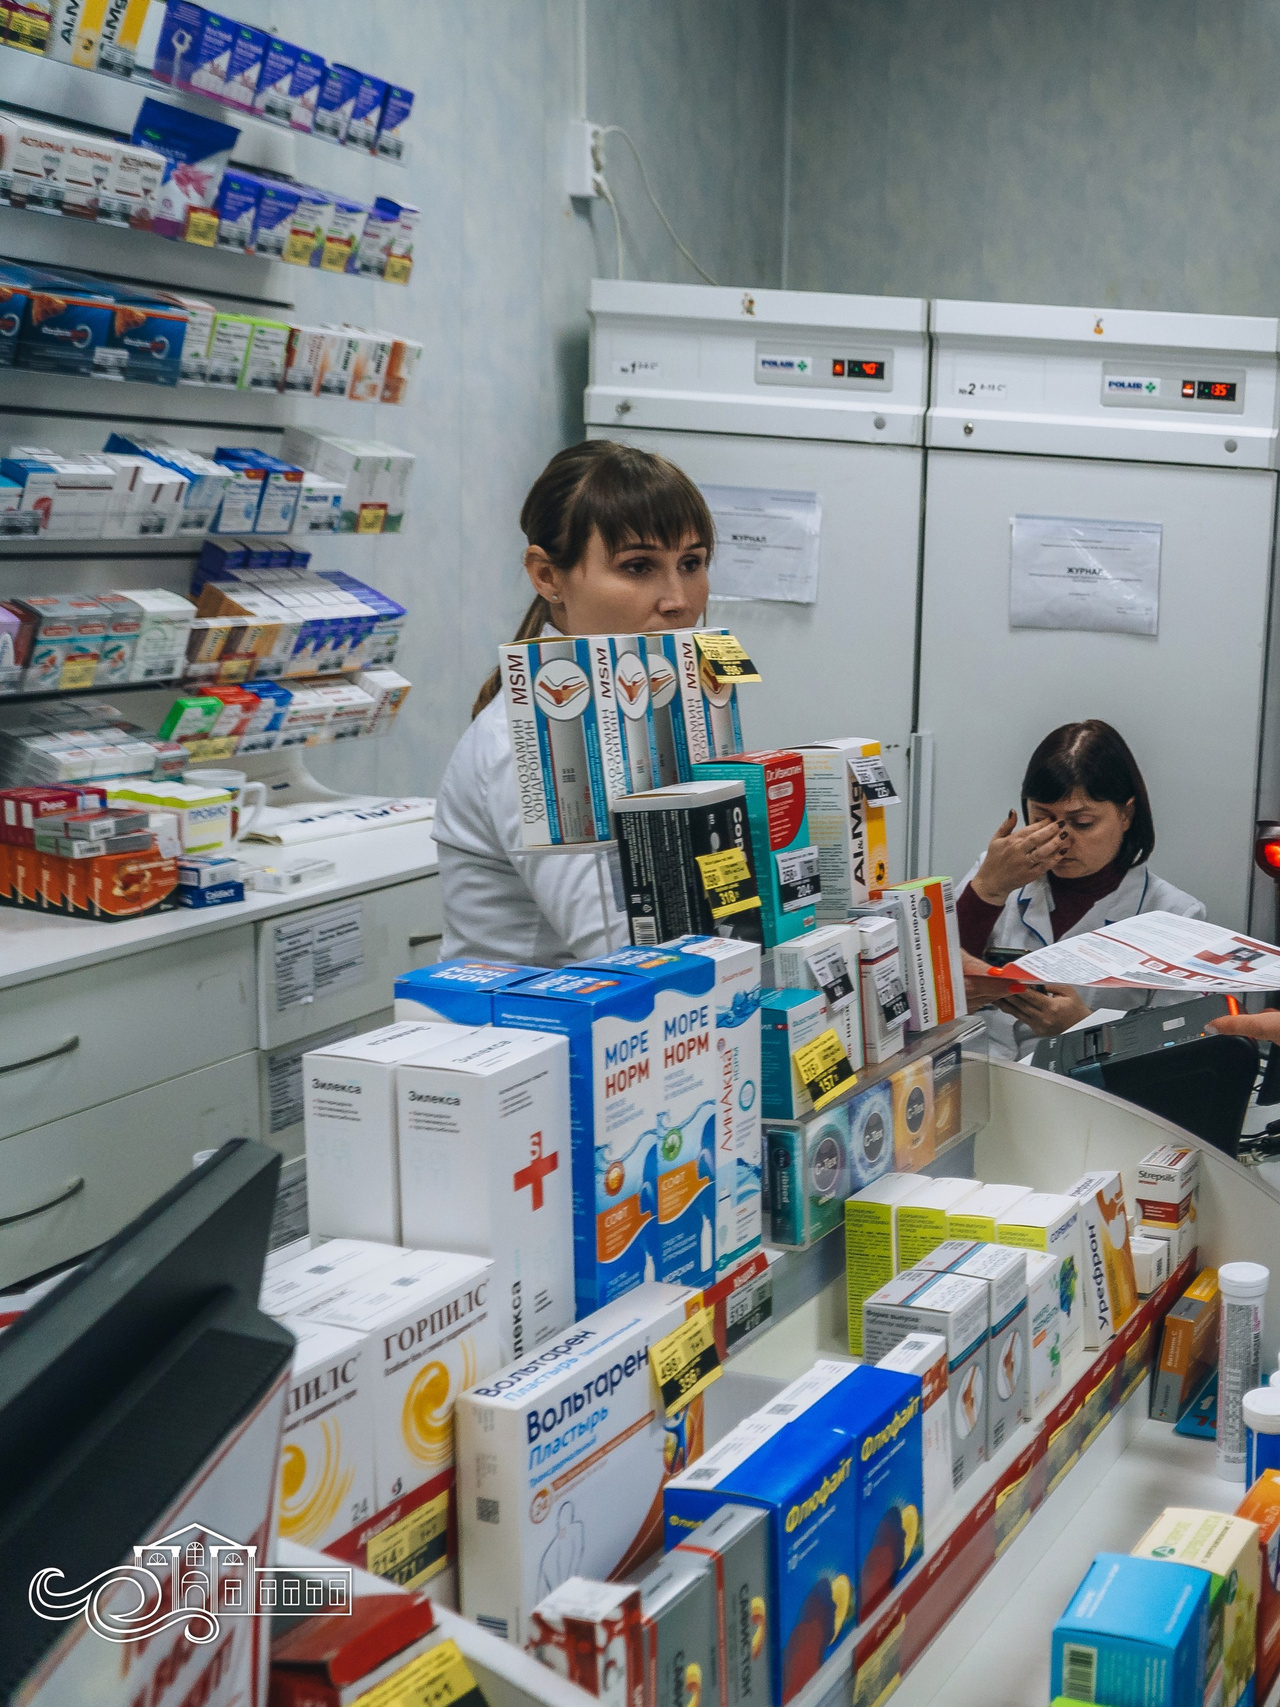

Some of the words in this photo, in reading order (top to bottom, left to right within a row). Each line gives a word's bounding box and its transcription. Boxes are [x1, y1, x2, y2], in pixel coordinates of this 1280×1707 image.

[760, 358, 795, 370] POLAIR
[1107, 379, 1143, 391] POLAIR
[1066, 566, 1103, 576] ЖУРНАЛ
[507, 653, 529, 706] MSM
[596, 647, 613, 699] MSM
[682, 642, 699, 690] MSM
[687, 698, 701, 765] ОЗАМИН
[697, 699, 708, 760] РОИТИН
[511, 718, 536, 826] ГЛЮКОЗАМИН
[523, 719, 546, 823] ХОНДРОИТИН
[796, 883, 812, 899] 204
[664, 1004, 709, 1042] МОРЕ
[452, 1038, 512, 1064] Зилекса
[604, 1029, 650, 1070] МОРЕ
[663, 1031, 710, 1069] НОРМ
[311, 1078, 363, 1095] Зилекса
[604, 1057, 651, 1099] НОРМ
[818, 1077, 836, 1095] 157
[407, 1090, 462, 1107] Зилекса
[906, 1099, 925, 1120] C-Tex
[863, 1128, 885, 1148] C-Tex
[661, 1170, 687, 1192] СОФТ
[815, 1155, 839, 1177] C-Tex
[1137, 1168, 1178, 1183] Strepsils
[603, 1205, 629, 1229] СОФТ
[1087, 1222, 1110, 1331] Урефрон
[383, 1282, 489, 1361] ГОРПИЛС
[473, 1330, 598, 1398] Вольтарен
[502, 1356, 580, 1402] Пластырь
[286, 1355, 359, 1416] ПИЛС
[525, 1344, 652, 1445] Вольтарен
[527, 1405, 610, 1471] Пластырь
[351, 1497, 369, 1523] 24
